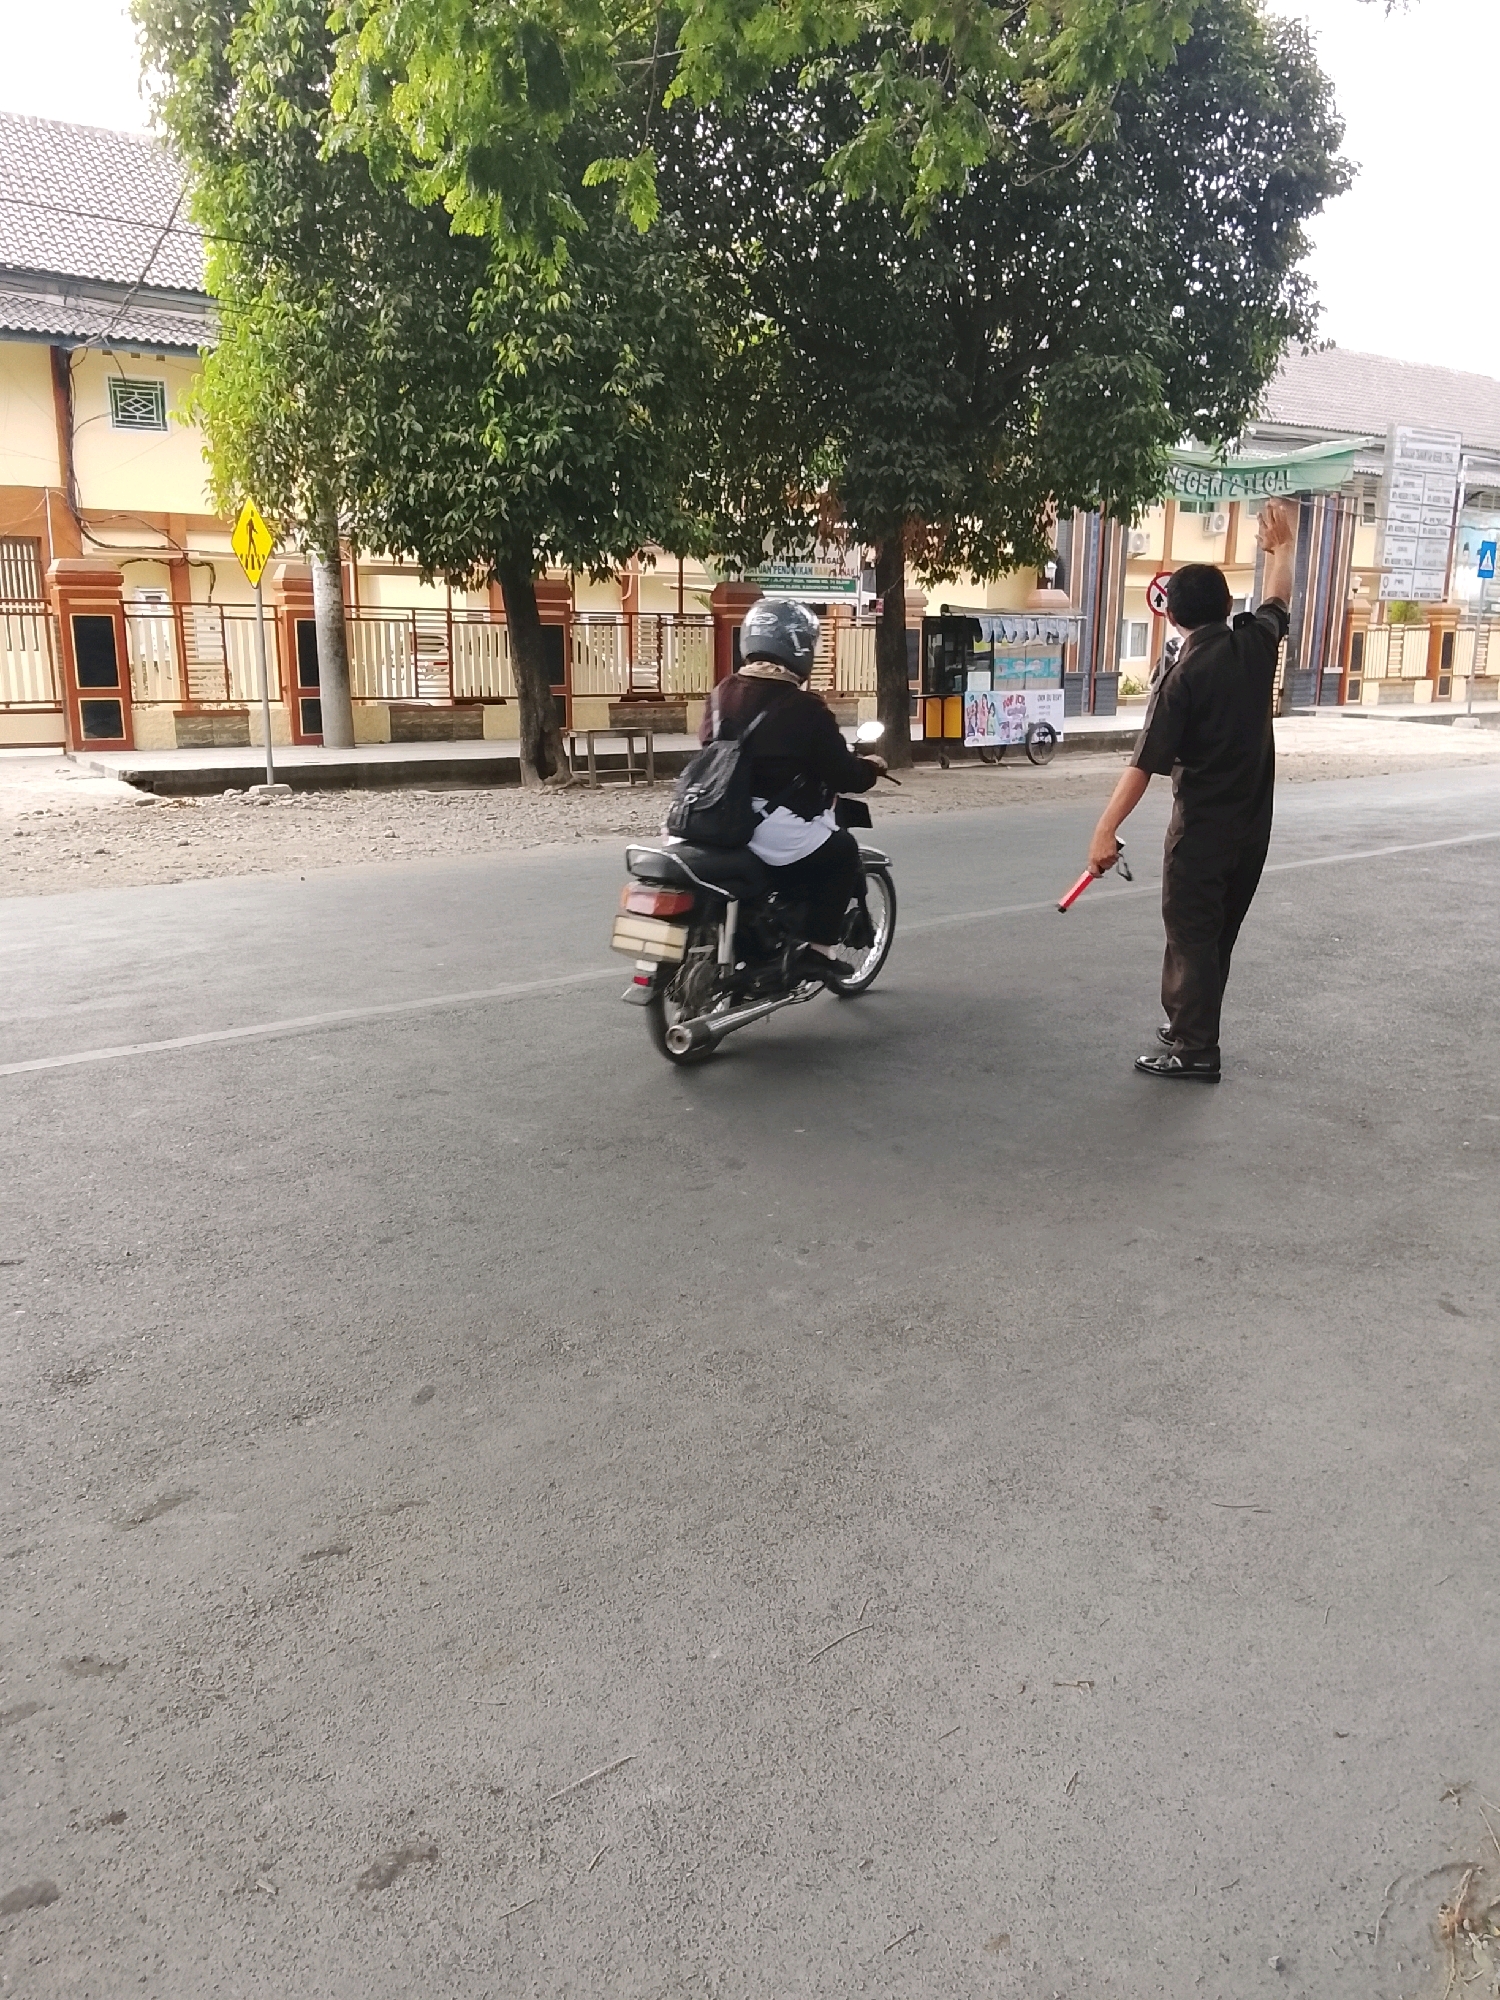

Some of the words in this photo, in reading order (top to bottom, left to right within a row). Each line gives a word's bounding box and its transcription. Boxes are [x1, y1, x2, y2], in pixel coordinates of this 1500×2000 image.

[1244, 469, 1292, 495] TEGAL
[817, 556, 840, 565] TGAL
[773, 565, 813, 576] PENDIKAN
